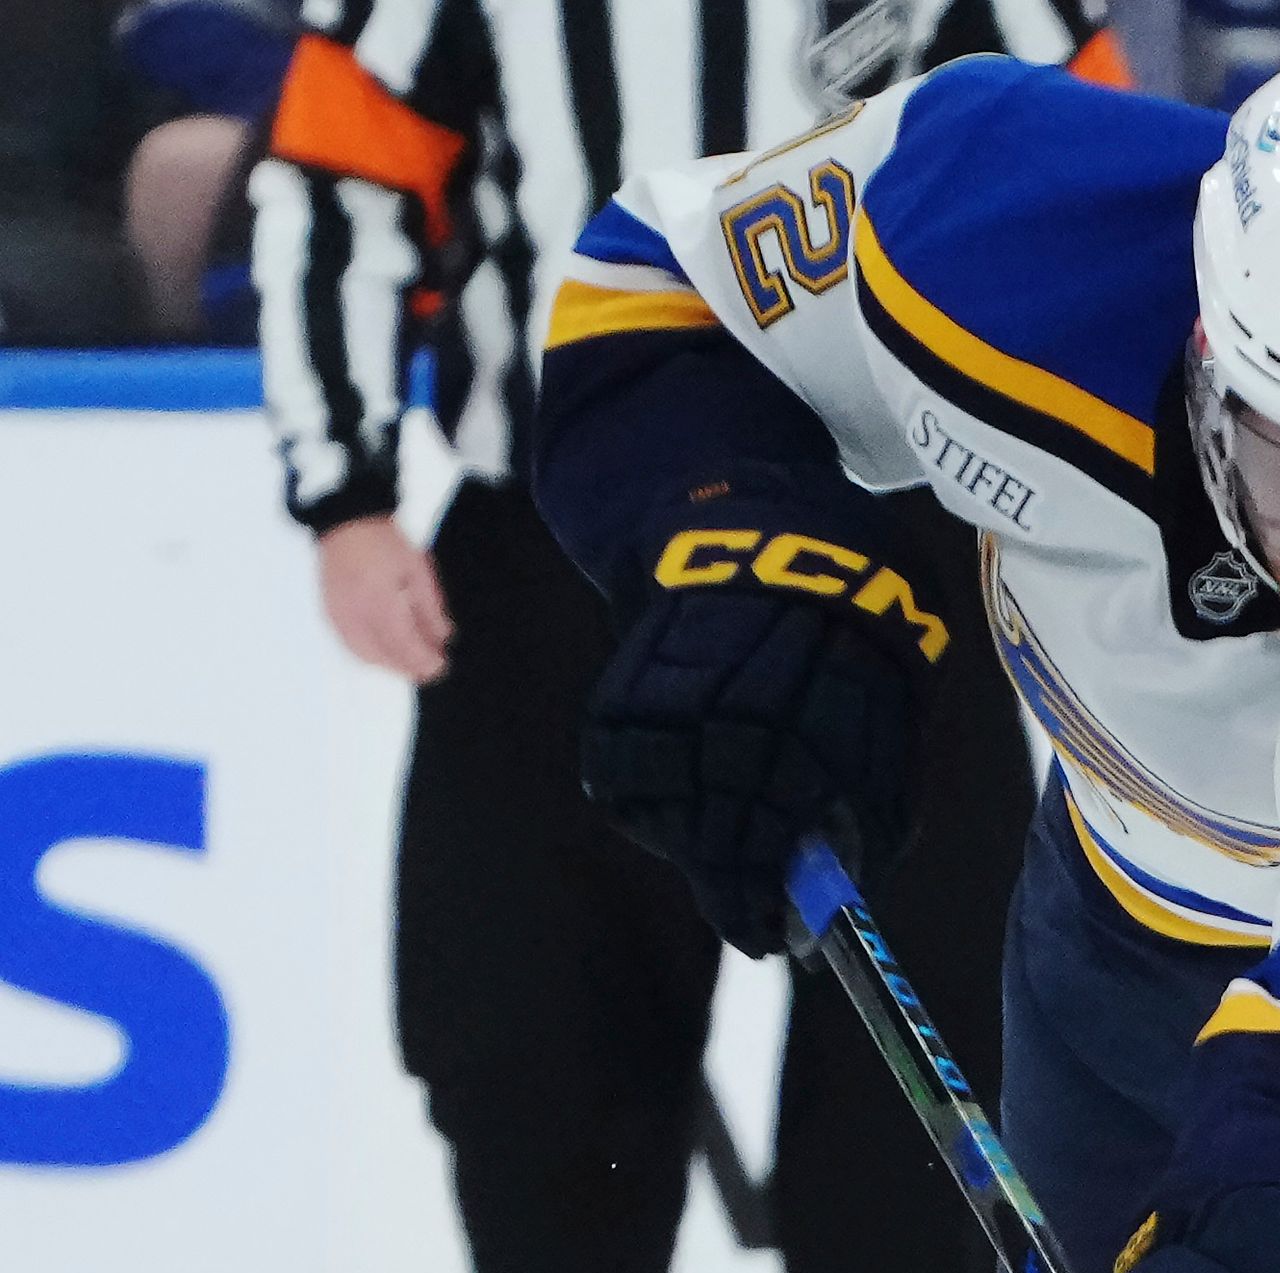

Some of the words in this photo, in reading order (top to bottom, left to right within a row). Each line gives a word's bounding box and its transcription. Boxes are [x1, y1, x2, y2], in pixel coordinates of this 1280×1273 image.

[719, 99, 867, 330] 2
[912, 409, 1037, 532] STIFEL
[654, 529, 950, 663] CCM
